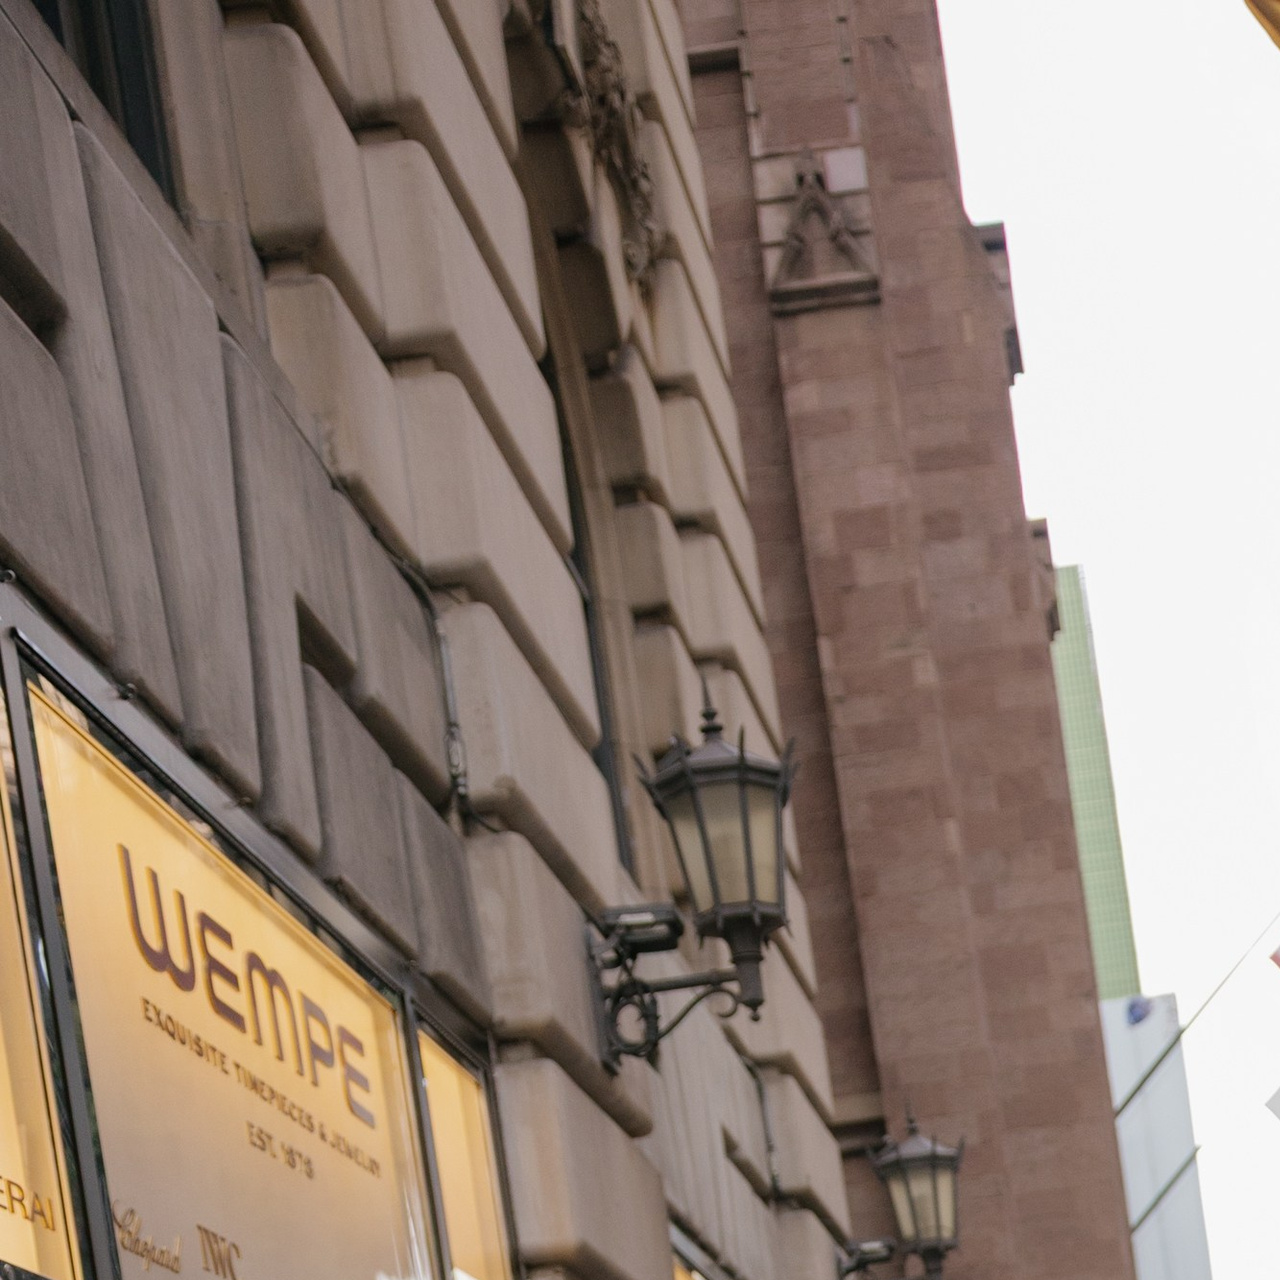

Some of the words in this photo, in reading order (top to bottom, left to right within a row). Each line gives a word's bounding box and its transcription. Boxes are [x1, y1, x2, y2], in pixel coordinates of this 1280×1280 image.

[117, 842, 377, 1130] WEMPE
[140, 996, 231, 1076] EXQUISITE
[234, 1061, 315, 1135] TIMEPIECES
[329, 1131, 383, 1179] JEWELRY
